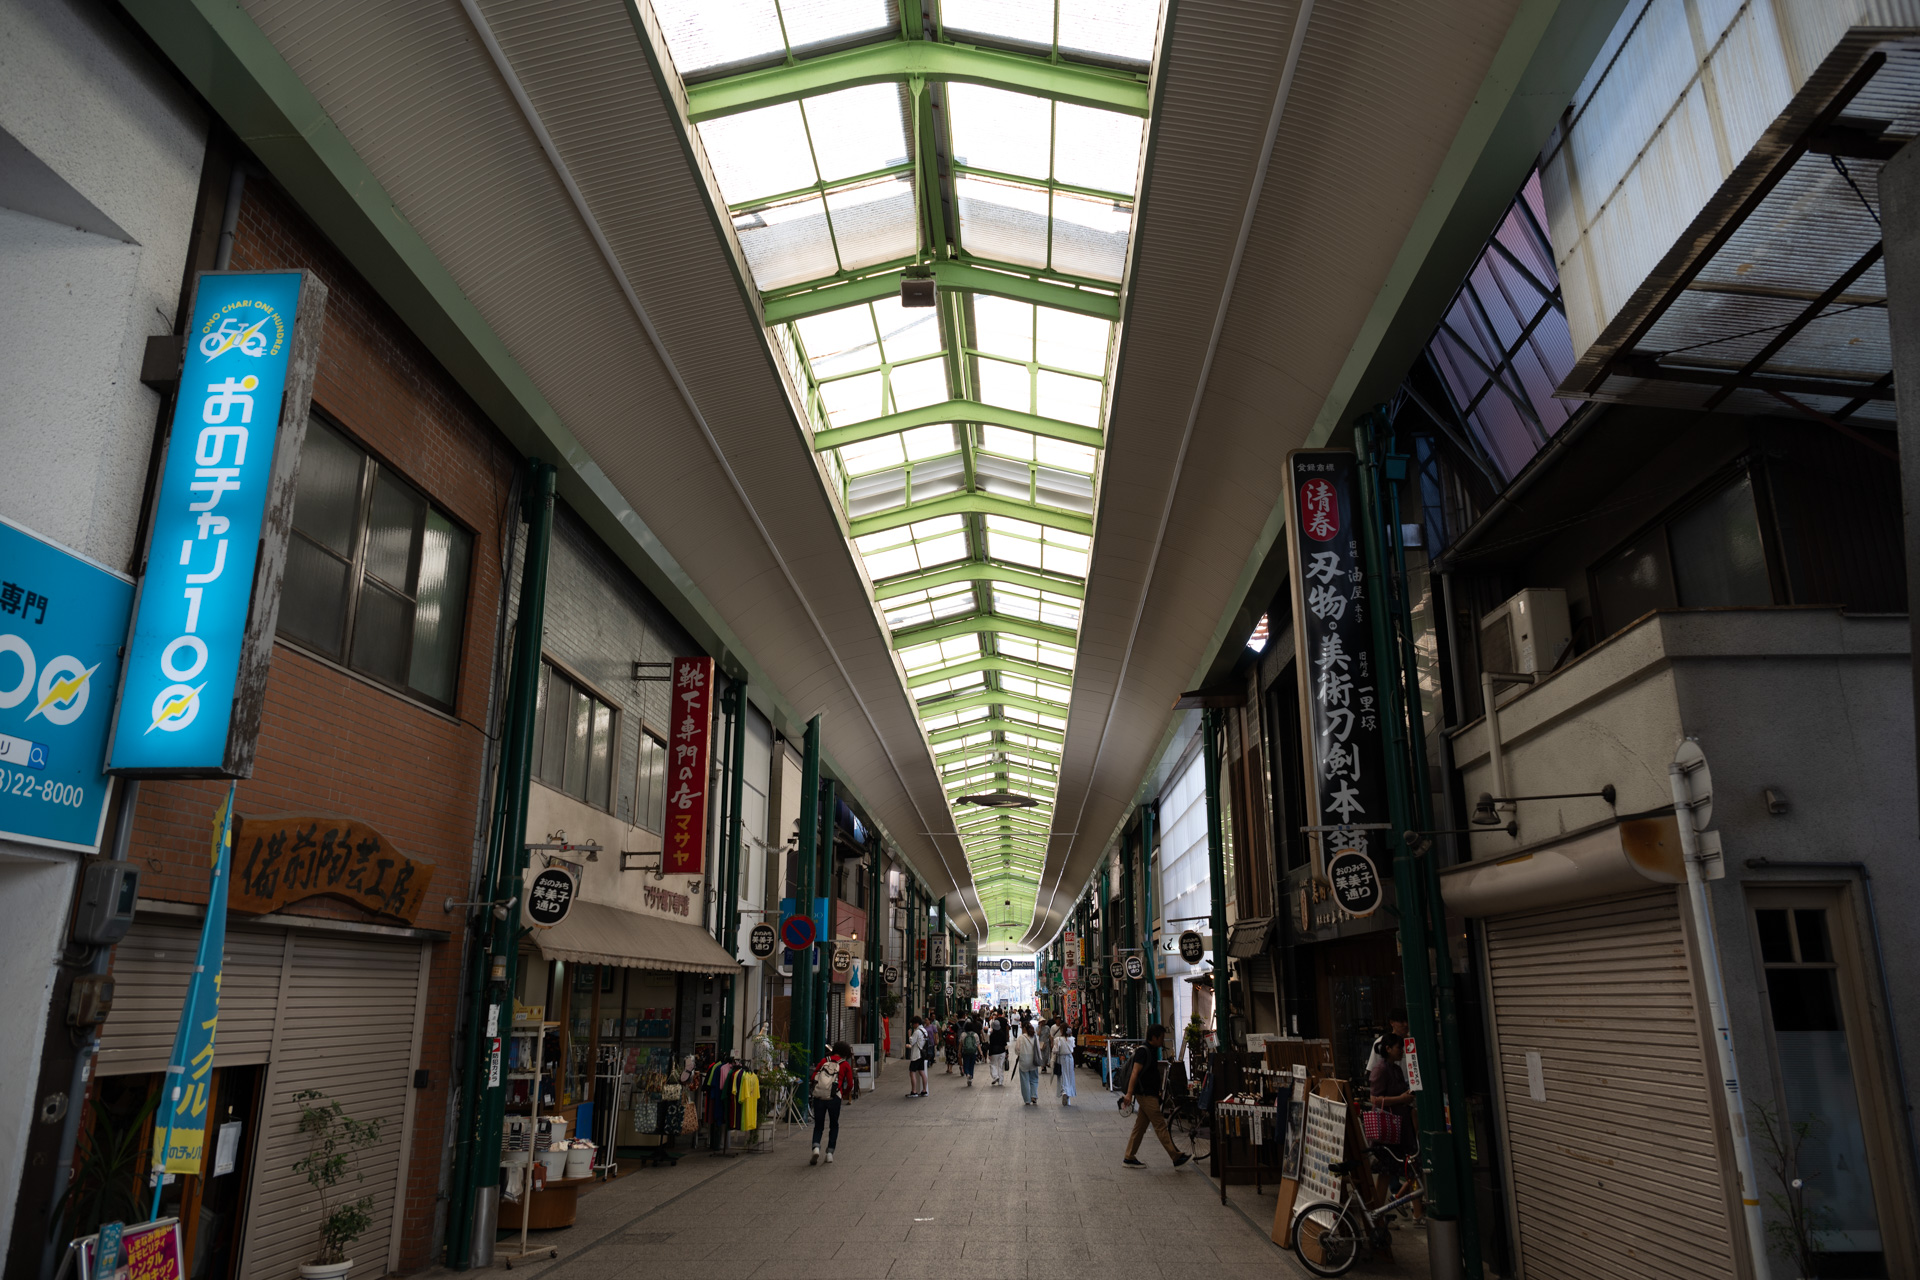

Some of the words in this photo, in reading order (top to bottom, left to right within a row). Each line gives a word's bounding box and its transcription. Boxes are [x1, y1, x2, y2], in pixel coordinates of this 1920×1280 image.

[202, 313, 221, 334] ONO
[222, 300, 252, 313] CHARI
[254, 301, 274, 315] ONE
[269, 312, 285, 356] HUNDRED
[1307, 481, 1337, 537] 清春
[1348, 566, 1365, 600] 油屋
[1358, 686, 1377, 732] 一里塚
[670, 663, 705, 810] 靴下専門の店
[673, 814, 692, 866] マサヤ
[539, 877, 570, 890] おのみち
[1335, 862, 1368, 876] おのみち
[1335, 871, 1374, 890] 芙美子
[533, 886, 570, 903] 芙美子
[535, 900, 561, 914] 通り
[1344, 887, 1371, 902] 通り
[130, 1251, 164, 1280] レンタル
